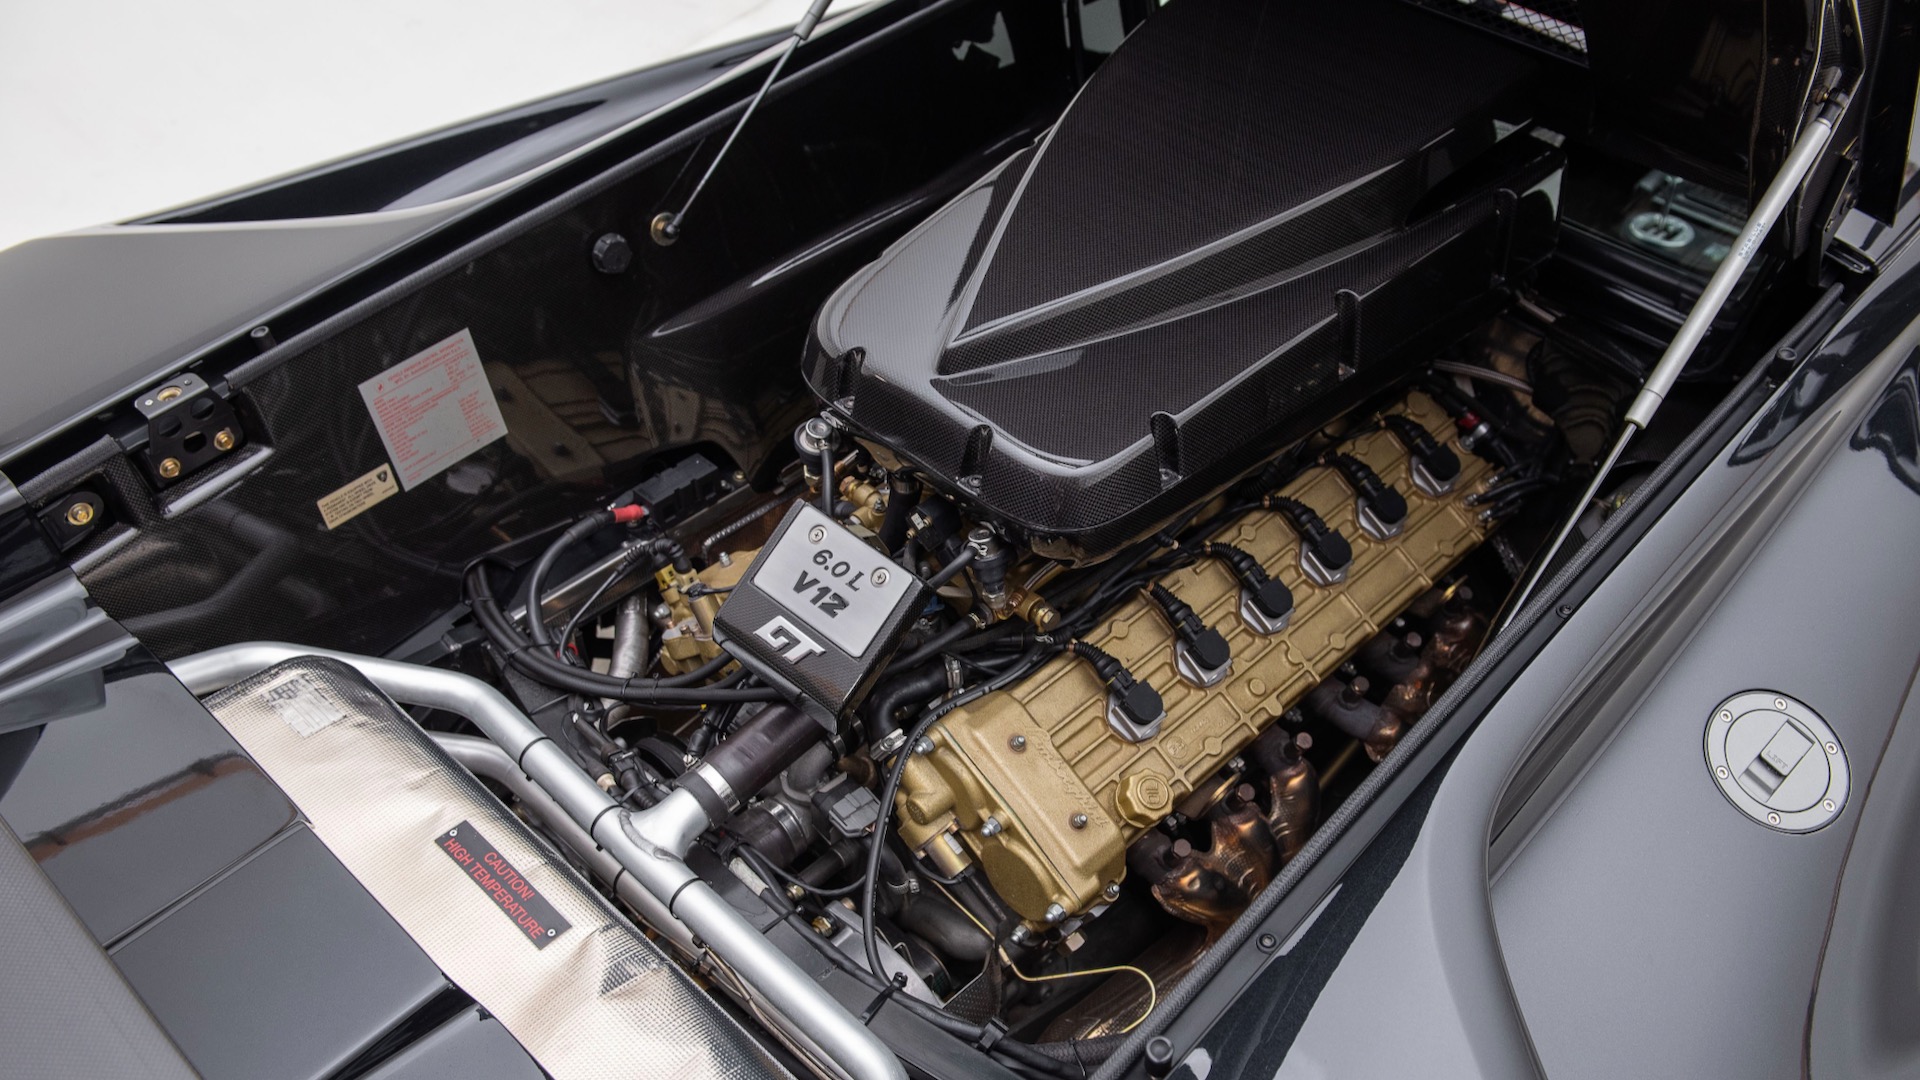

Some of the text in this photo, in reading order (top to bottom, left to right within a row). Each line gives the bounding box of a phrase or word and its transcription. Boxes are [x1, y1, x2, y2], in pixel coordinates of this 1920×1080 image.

[813, 549, 850, 578] 6.0
[792, 570, 850, 619] V12
[752, 615, 827, 665] GT
[1766, 750, 1789, 769] LIFT
[444, 838, 545, 939] HIGH TEMPERATURE
[484, 852, 535, 901] CAUTION!
